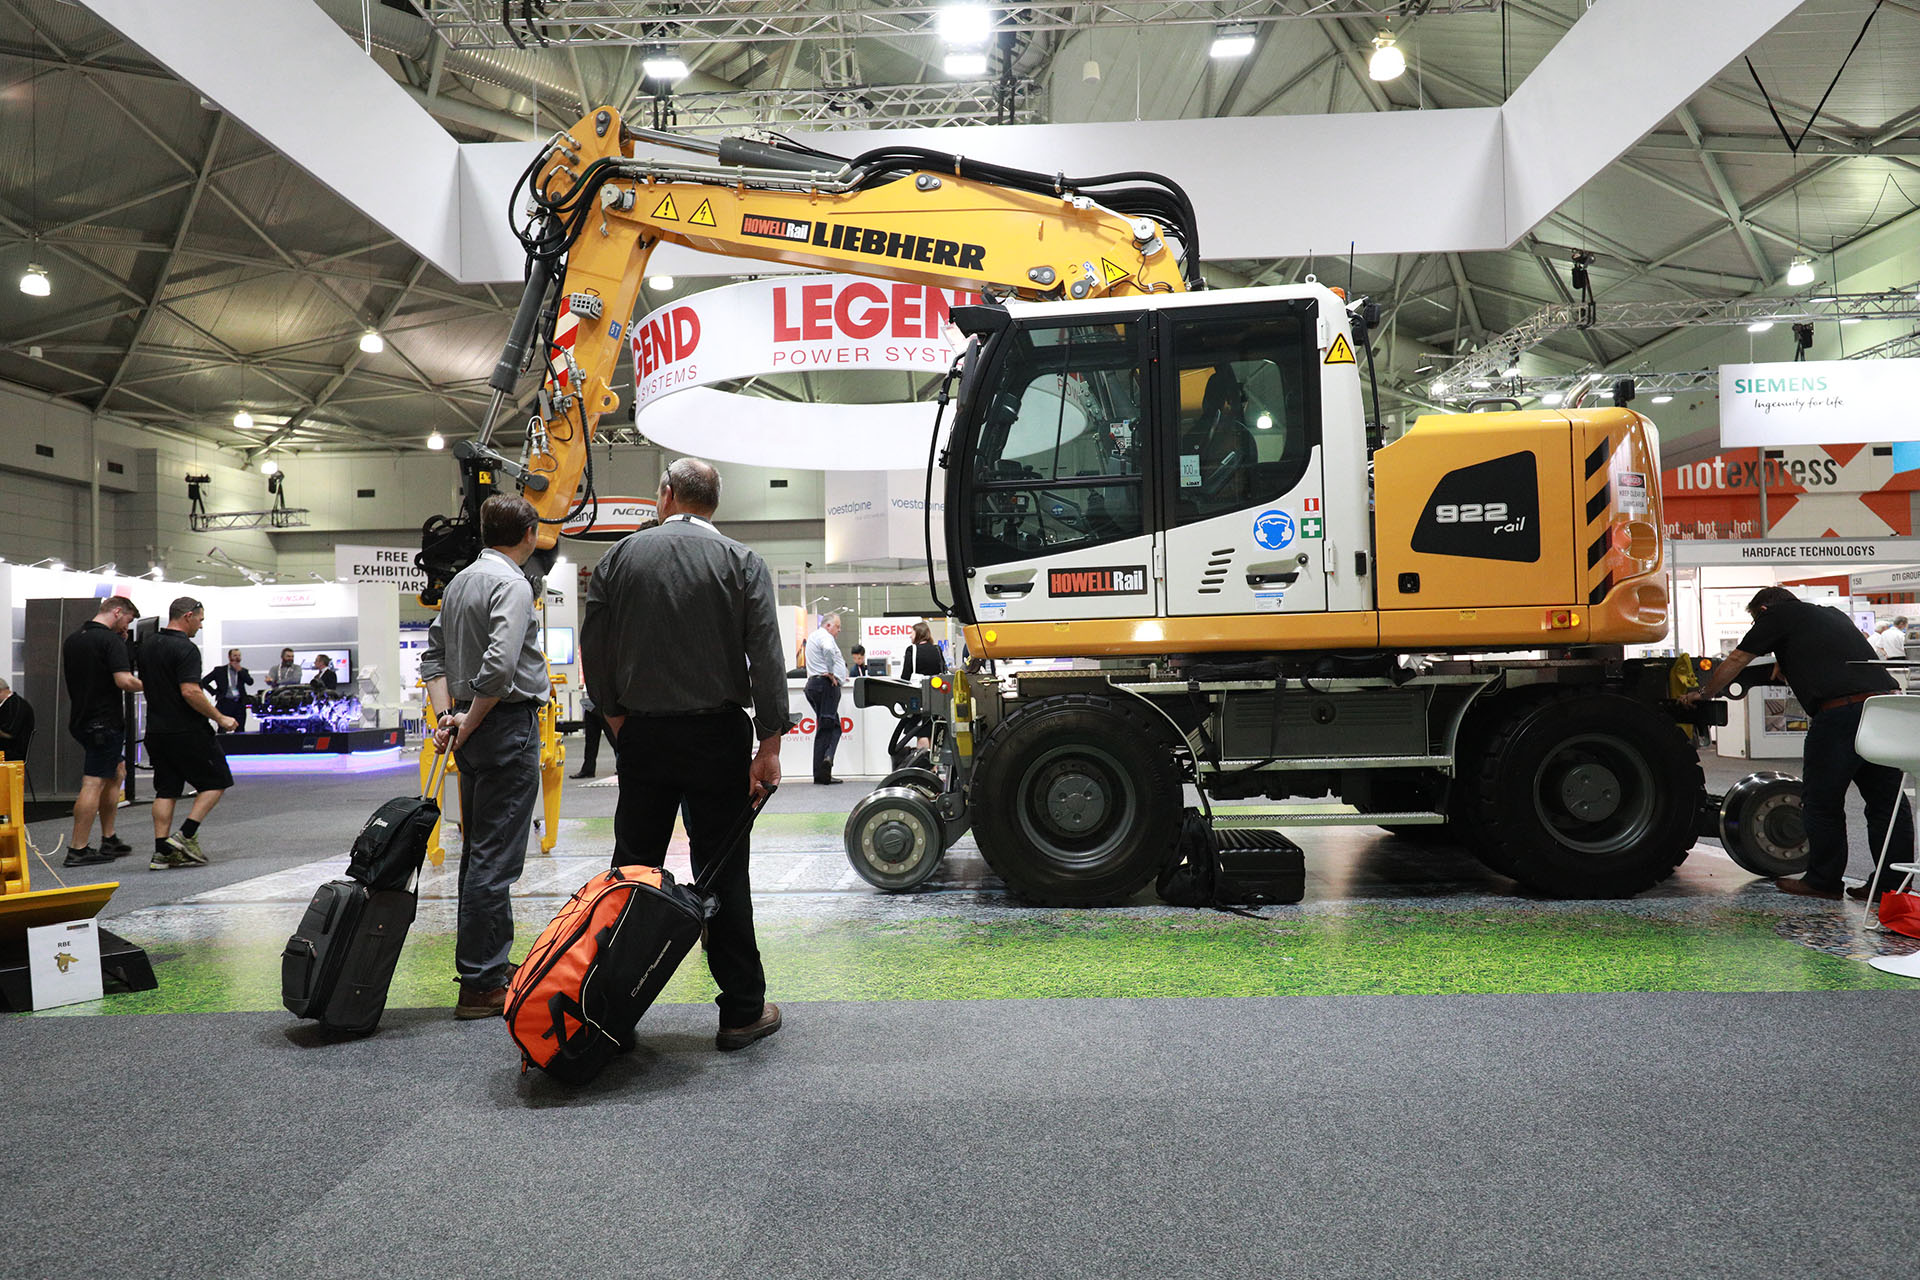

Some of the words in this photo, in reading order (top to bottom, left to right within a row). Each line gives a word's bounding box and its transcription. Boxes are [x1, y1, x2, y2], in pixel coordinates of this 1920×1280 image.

[812, 221, 987, 271] LIEBHERR
[773, 282, 984, 343] LEGEN
[773, 347, 870, 367] POWER
[885, 346, 952, 365] SYST
[641, 365, 698, 402] SYSTEMS
[1735, 376, 1828, 394] SIEMENS
[1808, 396, 1823, 409] for
[827, 500, 872, 516] voestalpine
[1435, 502, 1508, 523] 922
[1493, 516, 1525, 534] rail
[376, 551, 408, 562] FREE
[1743, 547, 1796, 558] HARDFACE
[1800, 545, 1875, 557] TECHNOLOGYS
[868, 625, 913, 636] LEGEND
